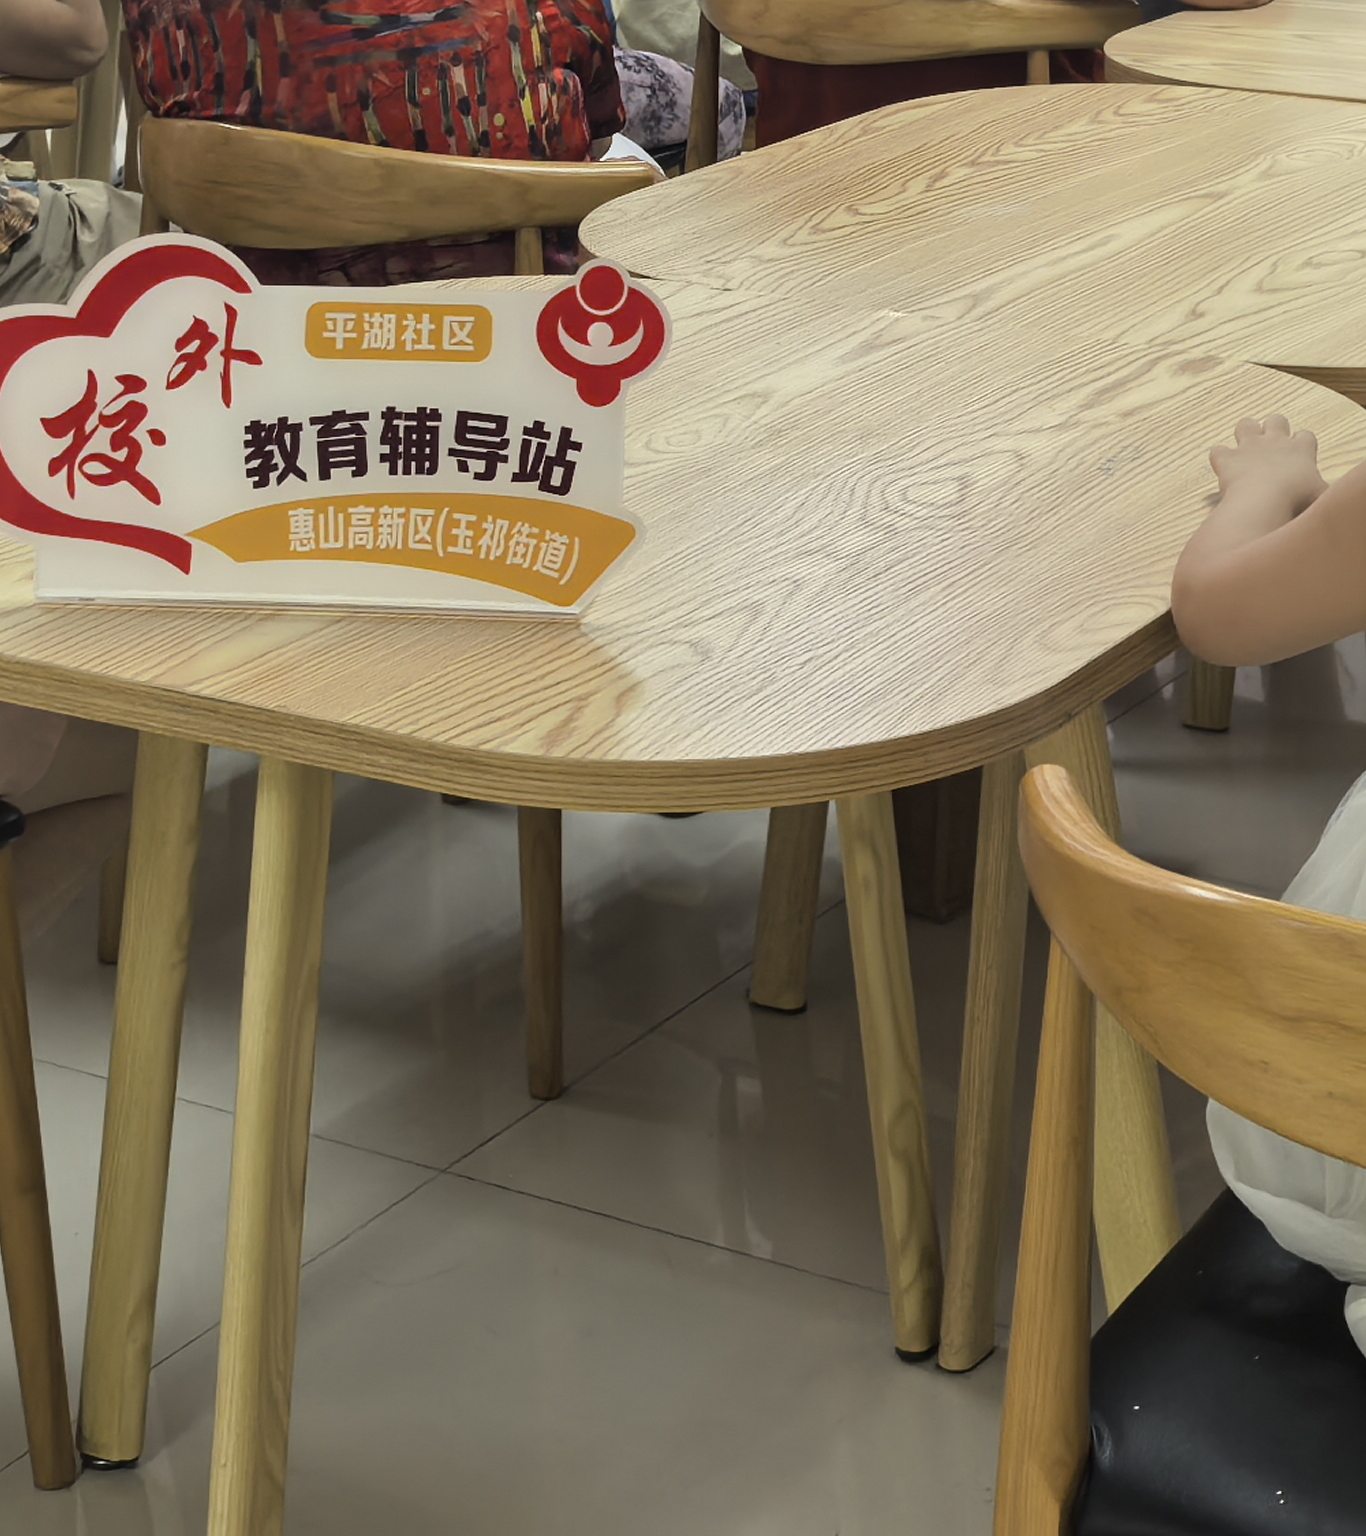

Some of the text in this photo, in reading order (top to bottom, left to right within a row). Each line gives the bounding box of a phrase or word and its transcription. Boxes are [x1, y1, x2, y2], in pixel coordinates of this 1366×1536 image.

[321, 310, 476, 353] 平湖社区
[39, 303, 263, 506] 校外
[243, 405, 585, 497] 教育辅导站
